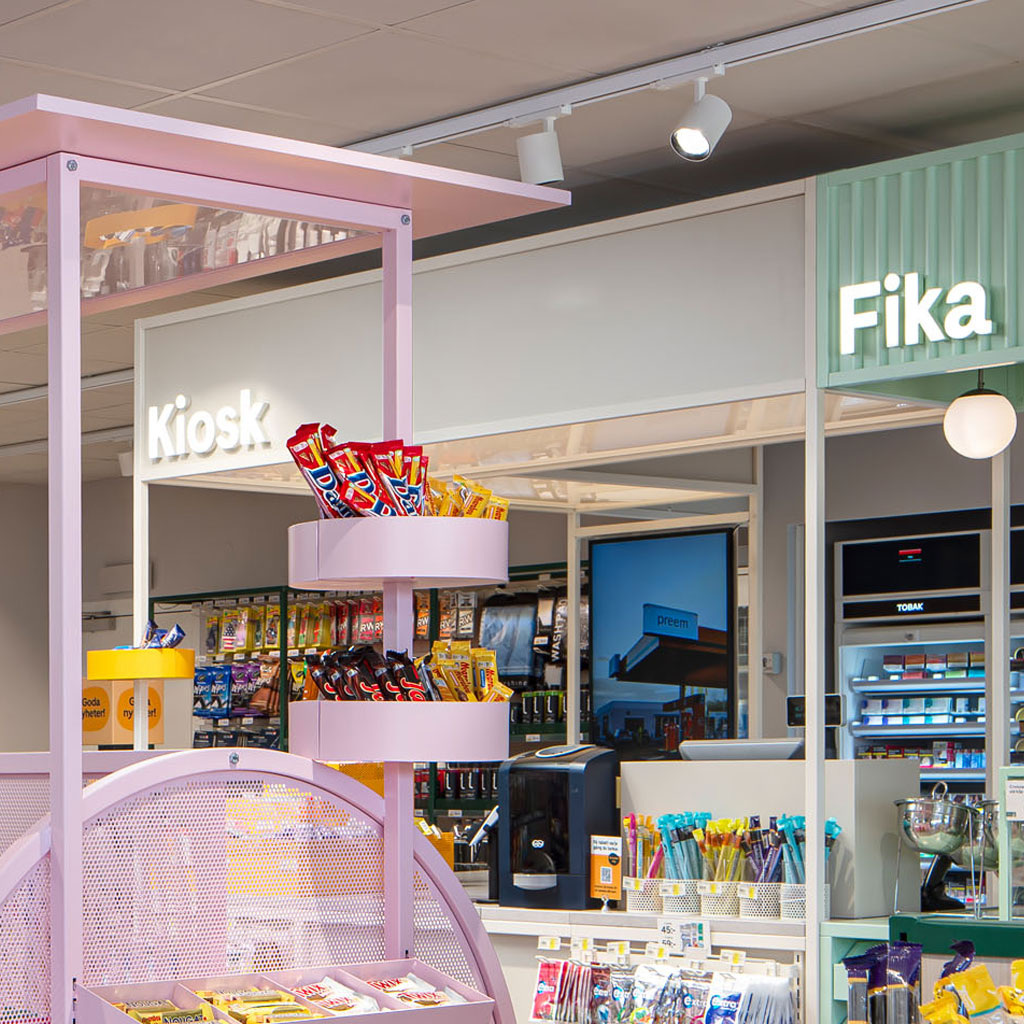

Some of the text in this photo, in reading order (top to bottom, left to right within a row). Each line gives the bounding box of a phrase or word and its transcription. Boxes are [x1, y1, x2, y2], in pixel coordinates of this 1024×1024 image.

[840, 271, 993, 355] Fika
[148, 389, 270, 461] Kiosk
[896, 602, 924, 612] TOBAK
[657, 611, 689, 631] preem
[82, 709, 106, 720] yheter!
[163, 1015, 204, 1024] NOUGAT
